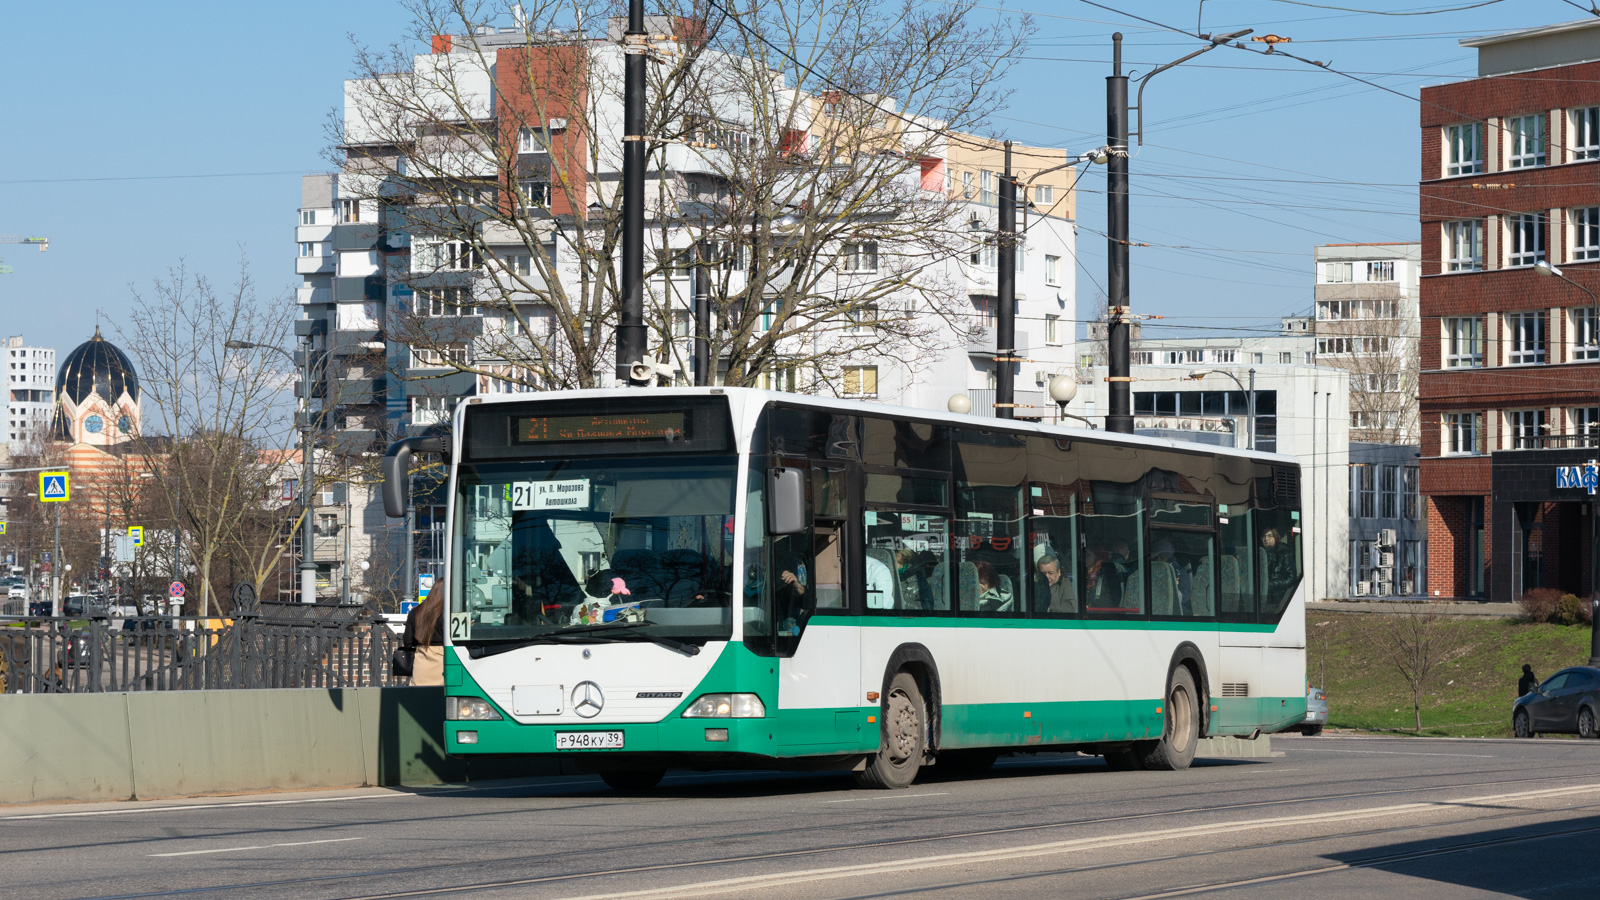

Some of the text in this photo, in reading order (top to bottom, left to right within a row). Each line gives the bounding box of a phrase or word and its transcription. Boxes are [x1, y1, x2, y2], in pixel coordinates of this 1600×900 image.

[528, 417, 548, 439] 21
[514, 486, 531, 507] 21
[539, 484, 584, 494] ул. П. Морозова
[545, 497, 578, 506] Автошкола
[451, 616, 468, 638] 21
[608, 733, 619, 743] 39
